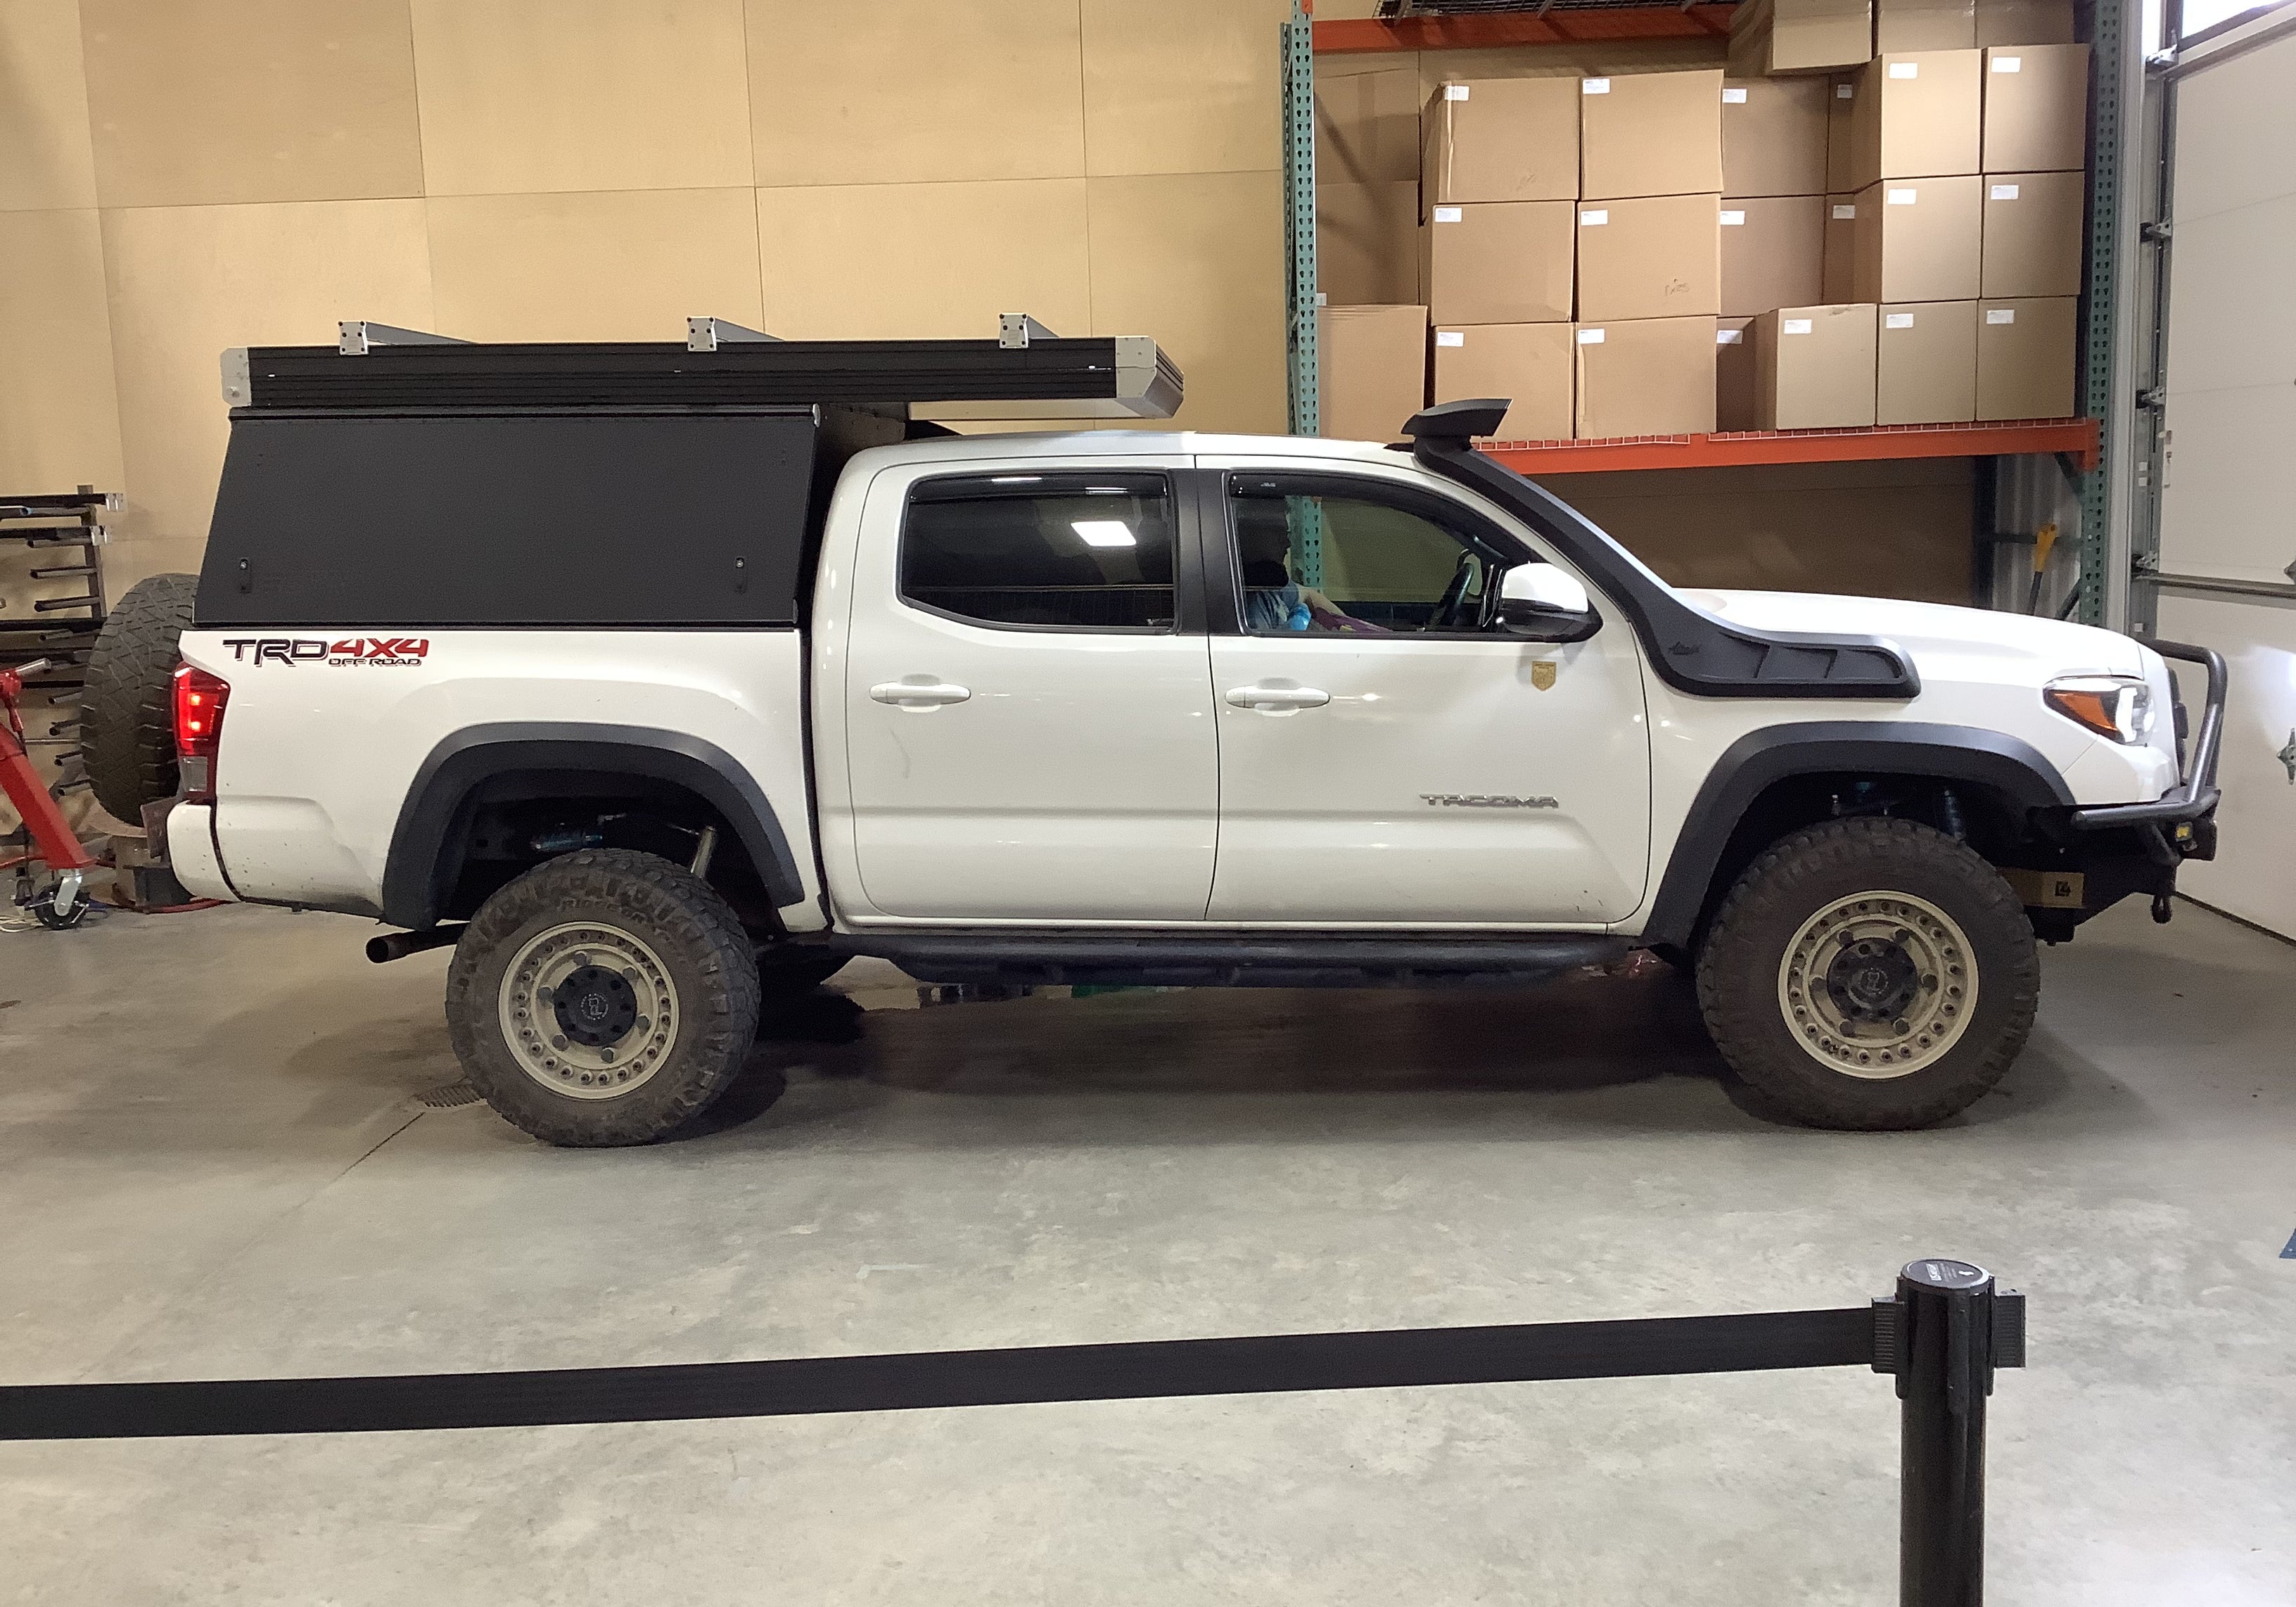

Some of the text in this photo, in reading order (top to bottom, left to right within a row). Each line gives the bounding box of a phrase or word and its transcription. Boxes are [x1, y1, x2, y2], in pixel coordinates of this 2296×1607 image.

[222, 638, 429, 667] TRD 4X4
[369, 659, 422, 667] ROAD
